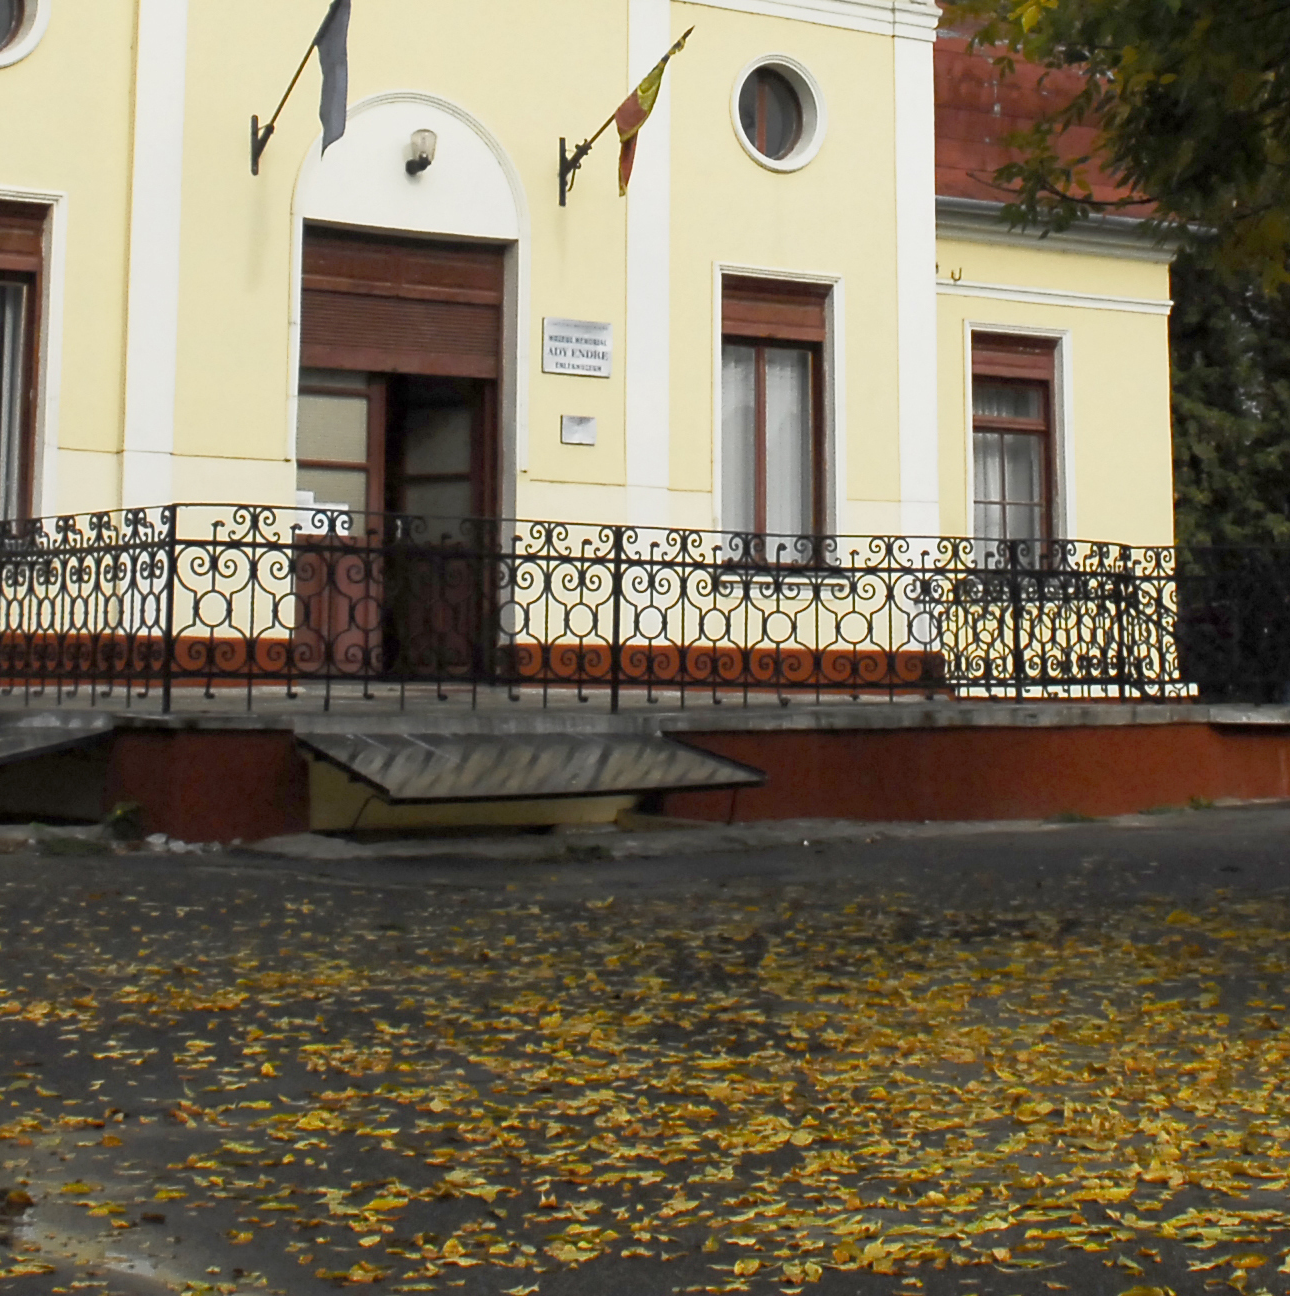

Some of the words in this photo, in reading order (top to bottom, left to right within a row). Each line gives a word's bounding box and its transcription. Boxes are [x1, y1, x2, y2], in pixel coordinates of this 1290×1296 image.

[575, 336, 607, 346] MEMORIAL
[548, 347, 567, 357] ADY
[571, 348, 608, 361] ENDRE
